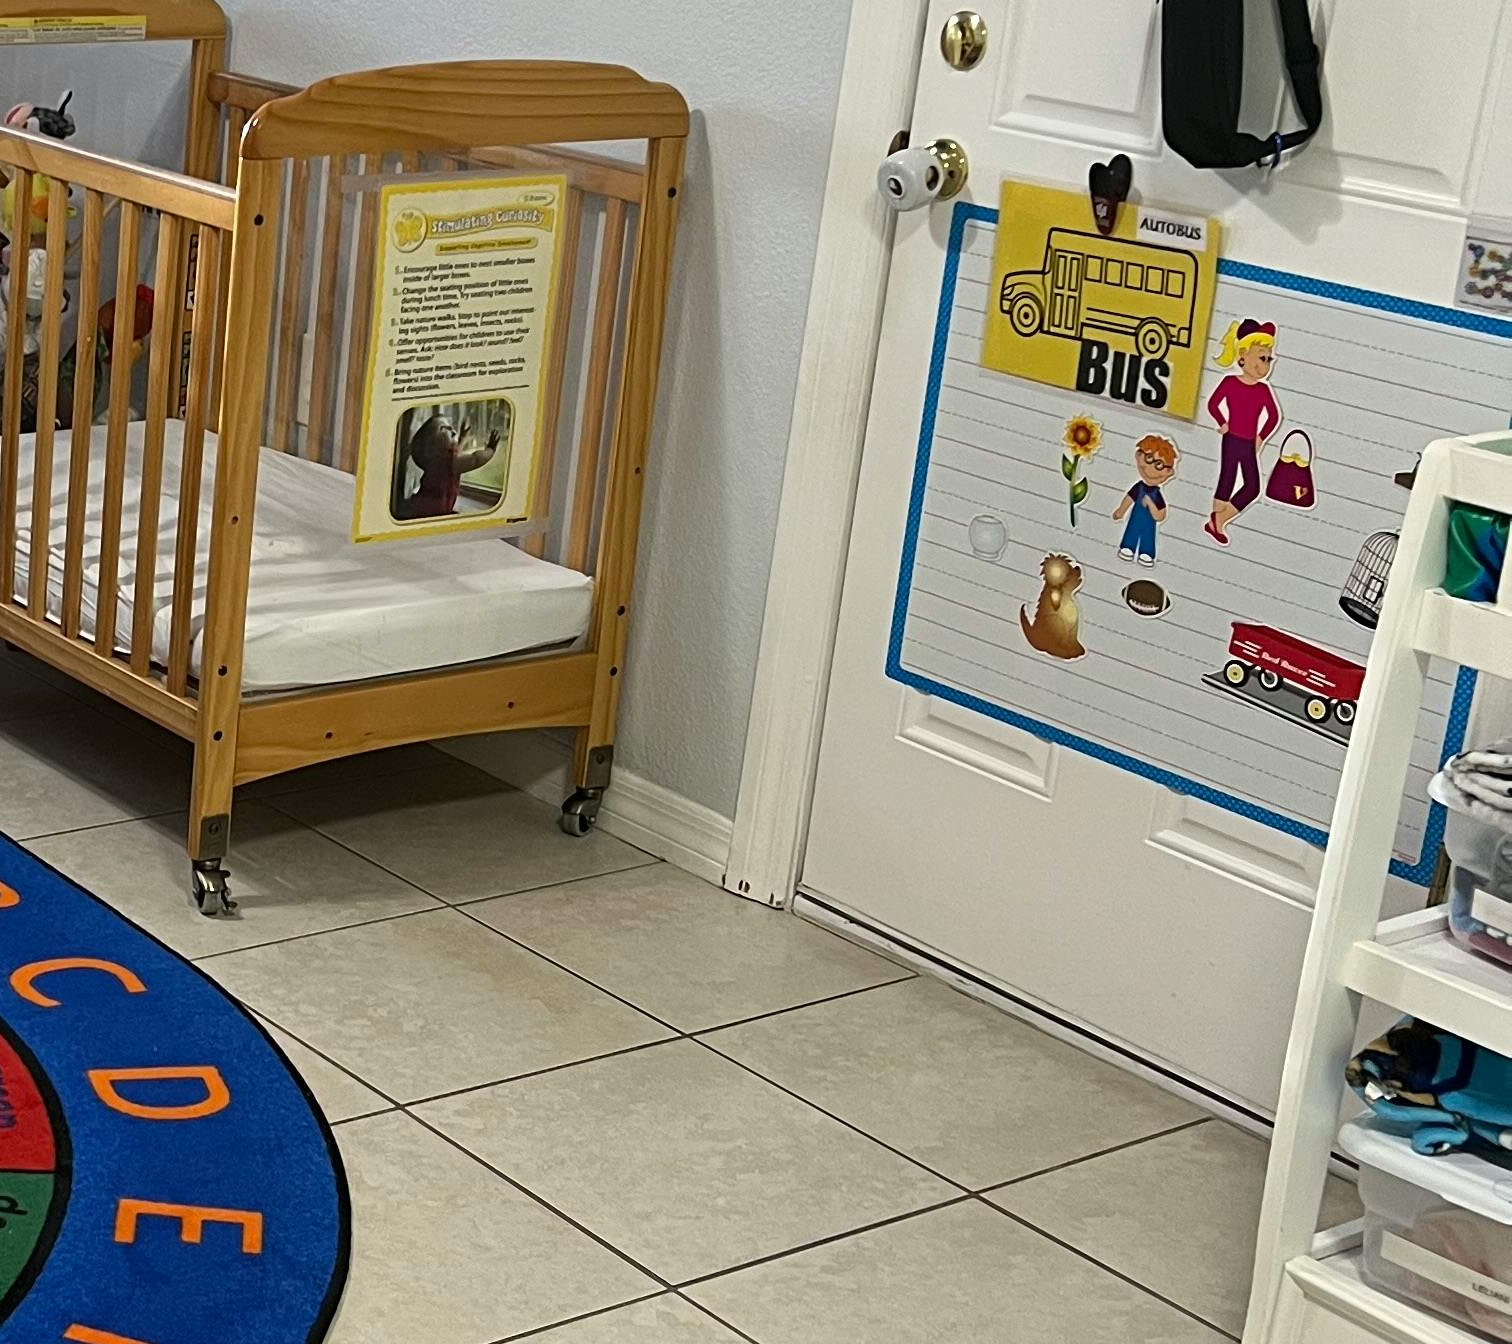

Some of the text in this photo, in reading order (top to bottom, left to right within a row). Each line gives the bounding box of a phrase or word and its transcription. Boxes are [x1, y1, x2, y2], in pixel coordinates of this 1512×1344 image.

[432, 209, 544, 233] Stimulating Curiosity
[1140, 217, 1201, 240] AUTOBUS
[494, 258, 516, 266] smaller
[424, 273, 430, 281] of
[403, 288, 426, 296] Change
[464, 282, 489, 291] position
[424, 294, 441, 302] lunch
[507, 287, 533, 295] children
[401, 306, 420, 314] facing
[400, 317, 414, 325] Take
[415, 335, 458, 344] opportunities
[394, 368, 411, 376] Bring
[445, 371, 477, 379] classroom
[9, 957, 148, 1009] C
[88, 1065, 231, 1121] D
[114, 1198, 262, 1255] E
